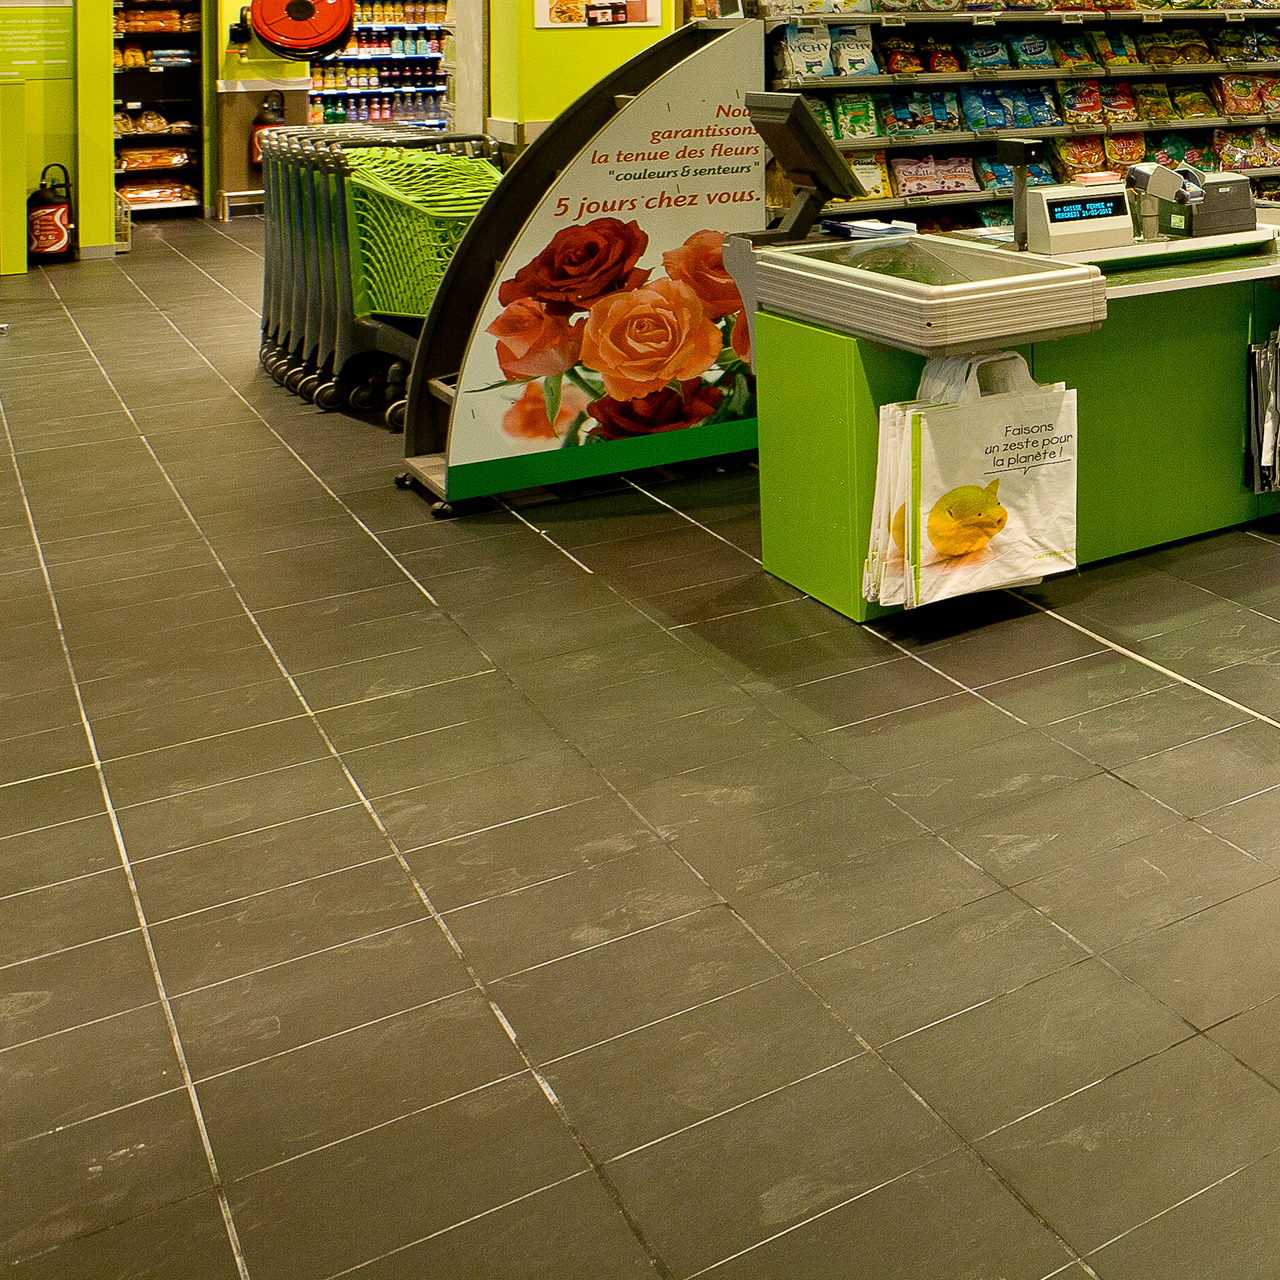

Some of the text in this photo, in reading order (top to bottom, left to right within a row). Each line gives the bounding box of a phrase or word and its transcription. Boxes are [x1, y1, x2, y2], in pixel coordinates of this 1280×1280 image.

[789, 42, 830, 53] VICHY
[715, 104, 751, 119] Nou
[591, 143, 760, 164] la tenue des fleurs
[681, 165, 692, 177] &
[554, 190, 761, 222] 5 jours chez vous.
[1004, 423, 1054, 437] Faisons
[984, 434, 1073, 455] un zeste pour
[993, 456, 1004, 467] la
[1007, 449, 1056, 468] planète
